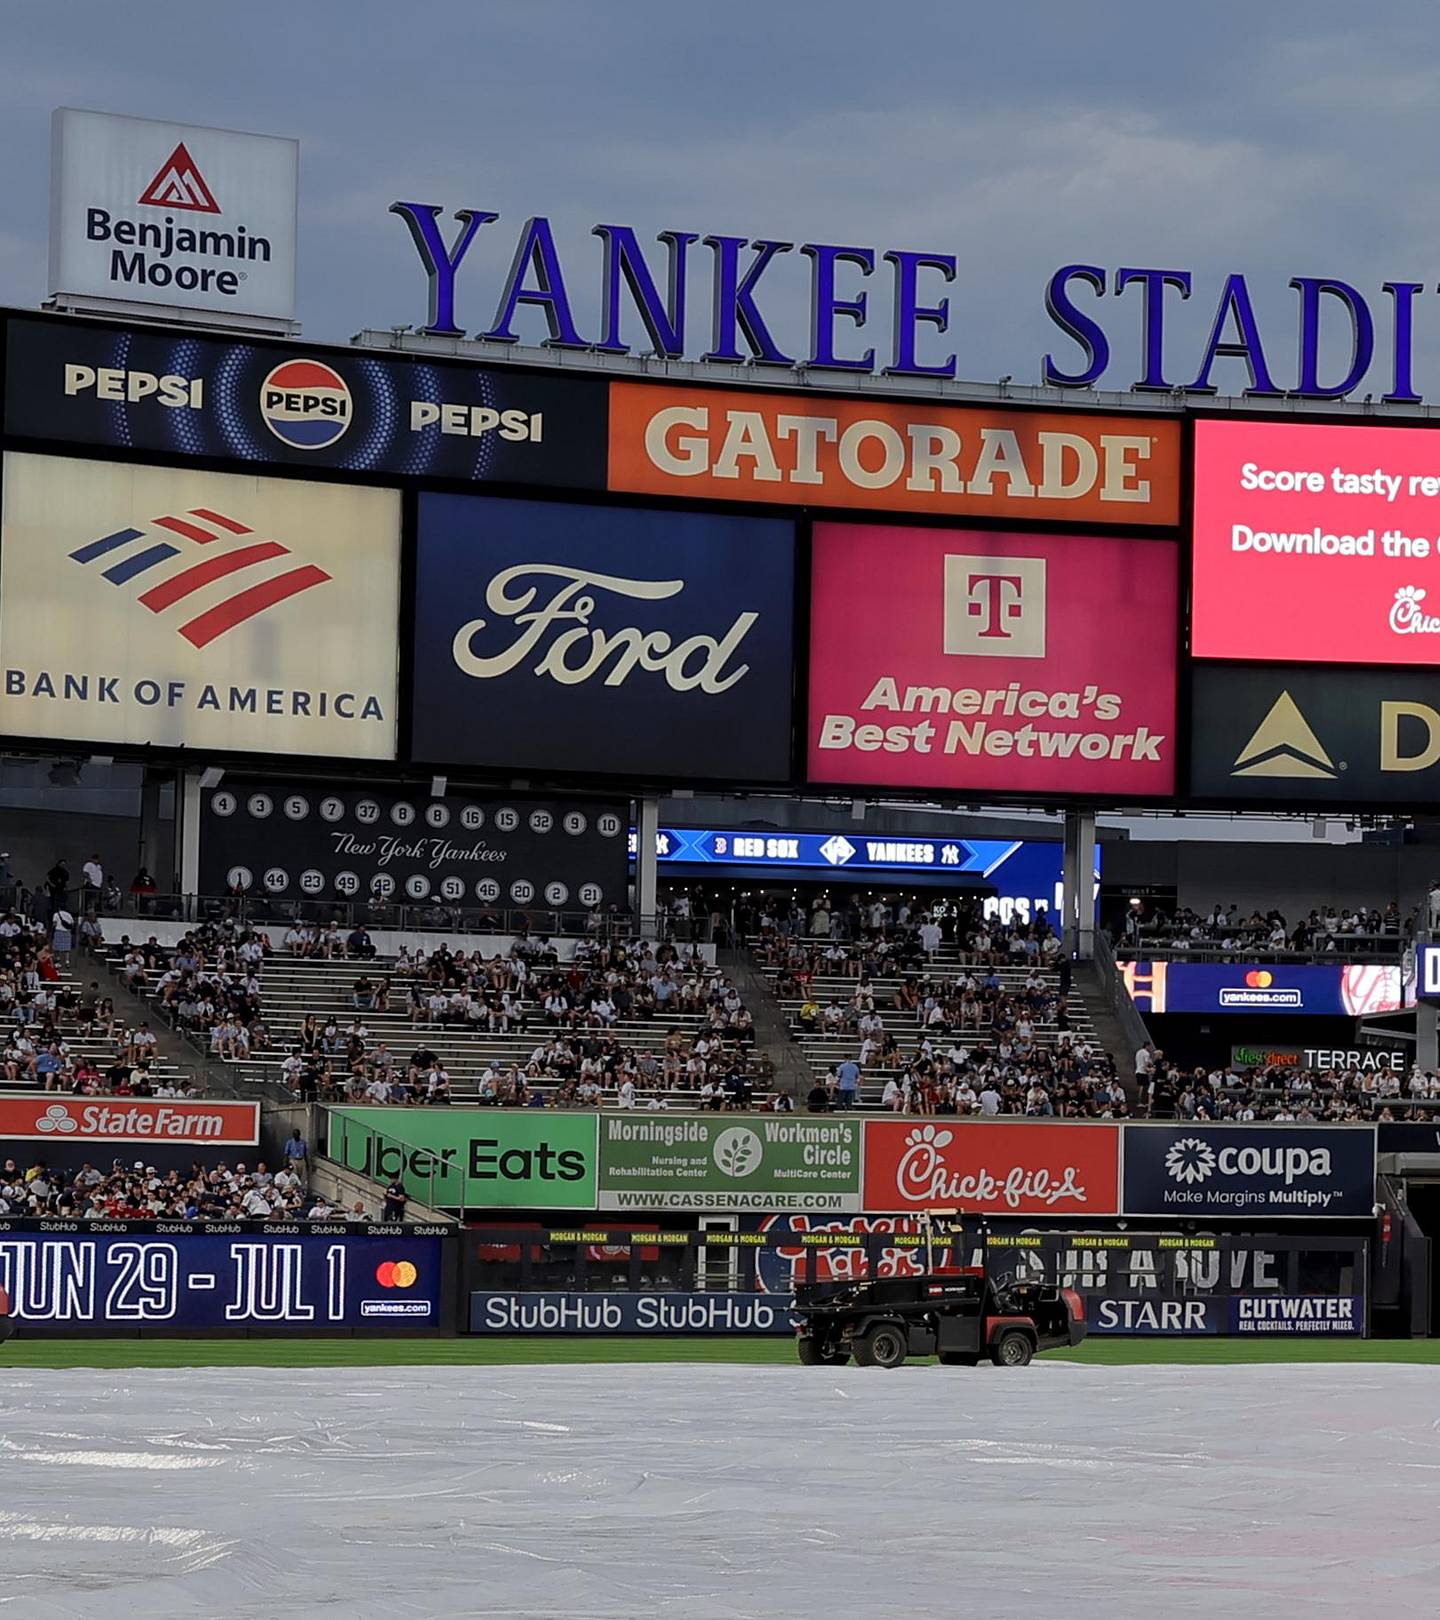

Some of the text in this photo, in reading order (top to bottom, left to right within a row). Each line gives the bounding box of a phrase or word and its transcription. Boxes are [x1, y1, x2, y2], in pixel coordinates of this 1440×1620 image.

[86, 207, 271, 262] Benjamin
[110, 249, 239, 294] Moore
[388, 201, 957, 379] YANKEE
[64, 363, 202, 409] PEPSI
[266, 391, 347, 417] PEPSI
[410, 401, 542, 442] PEPSI
[644, 406, 1151, 502] GATORADE
[1240, 463, 1325, 494] Score
[1331, 467, 1401, 502] tasty
[1231, 525, 1375, 556] Download
[1381, 530, 1430, 558] the
[453, 563, 759, 694] Ford
[5, 669, 385, 721] BANK OF AMERICA
[861, 676, 1121, 721] America's
[819, 715, 1165, 761] Best Network
[219, 799, 227, 810] 4
[256, 800, 264, 812] 3
[292, 802, 300, 814] 5
[328, 804, 336, 816] 7
[359, 805, 376, 818] 37
[399, 808, 407, 820] 8
[433, 810, 441, 822] 8
[466, 811, 479, 824] 16
[500, 814, 513, 826] 15
[534, 815, 549, 828] 32
[571, 817, 579, 829] 9
[602, 819, 615, 831] 10
[330, 832, 507, 869] New York Yankees
[733, 837, 934, 864] RED SOX YANKEES
[267, 873, 285, 885] 44
[304, 876, 321, 888] 23
[338, 876, 355, 889] 49
[414, 881, 422, 893] 6
[446, 882, 460, 894] 51
[479, 884, 495, 896] 46
[515, 886, 530, 898] 20
[552, 888, 561, 899] 2
[584, 889, 597, 901] 21
[1223, 991, 1297, 1004] yankees.com
[1304, 1050, 1404, 1072] TERRACE
[608, 1120, 709, 1147] Morningside
[765, 1122, 852, 1144] Workmen's
[342, 1135, 586, 1181] Uber Eats
[652, 1156, 707, 1167] Nursing and
[803, 1145, 851, 1166] Circle
[896, 1124, 1088, 1206] Chick-fil-A
[1217, 1146, 1332, 1185] coupa
[609, 1167, 708, 1178] Rehabilitation Center
[774, 1169, 852, 1179] MultiCare Center
[618, 1193, 842, 1208] WWW.CASSENACARE.COM
[1164, 1190, 1202, 1203] Make
[1207, 1190, 1265, 1206] Margins
[40, 1221, 78, 1232] StubHub
[90, 1222, 127, 1232] StubHub
[156, 1223, 193, 1233] StubHub
[205, 1223, 241, 1233] StubHub
[263, 1224, 299, 1234] StubHub
[311, 1225, 346, 1234] StubHub
[367, 1226, 402, 1235] StubHub
[413, 1226, 449, 1235] StubHub
[0, 1242, 96, 1319] JUN
[105, 1243, 178, 1319] 29
[225, 1243, 314, 1320] JUL
[326, 1245, 346, 1320] 1
[364, 1302, 428, 1315] yankees.com
[484, 1297, 622, 1330] StubHub
[635, 1299, 774, 1329] StubHub
[1098, 1299, 1353, 1330] STARR CUTWATER
[1239, 1320, 1255, 1331] REAL
[1257, 1320, 1294, 1331] COCKTAILS.
[1295, 1320, 1330, 1330] PERFECTLY
